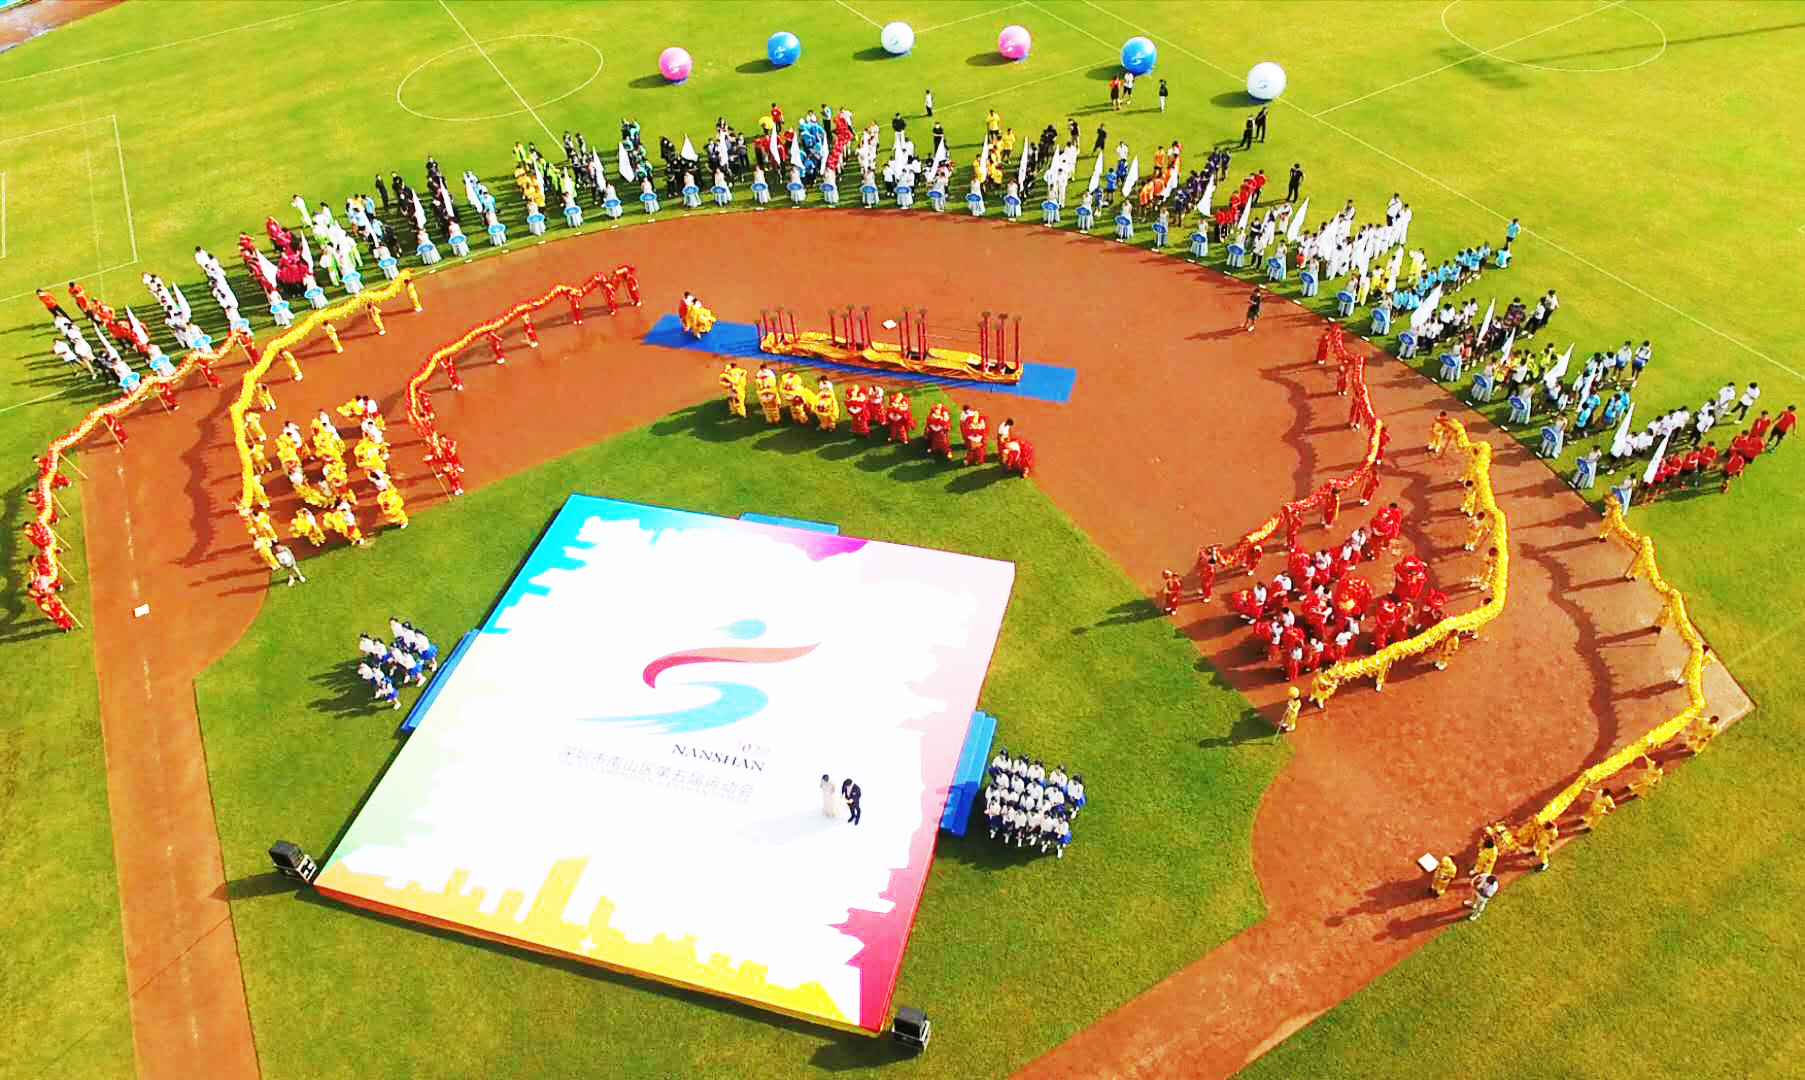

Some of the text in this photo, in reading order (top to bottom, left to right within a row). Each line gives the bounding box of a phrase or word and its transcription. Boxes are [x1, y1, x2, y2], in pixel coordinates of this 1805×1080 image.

[673, 744, 764, 771] NANSHAN
[735, 741, 770, 757] 2020
[558, 745, 754, 797] 深圳市南山区第五届运动会
